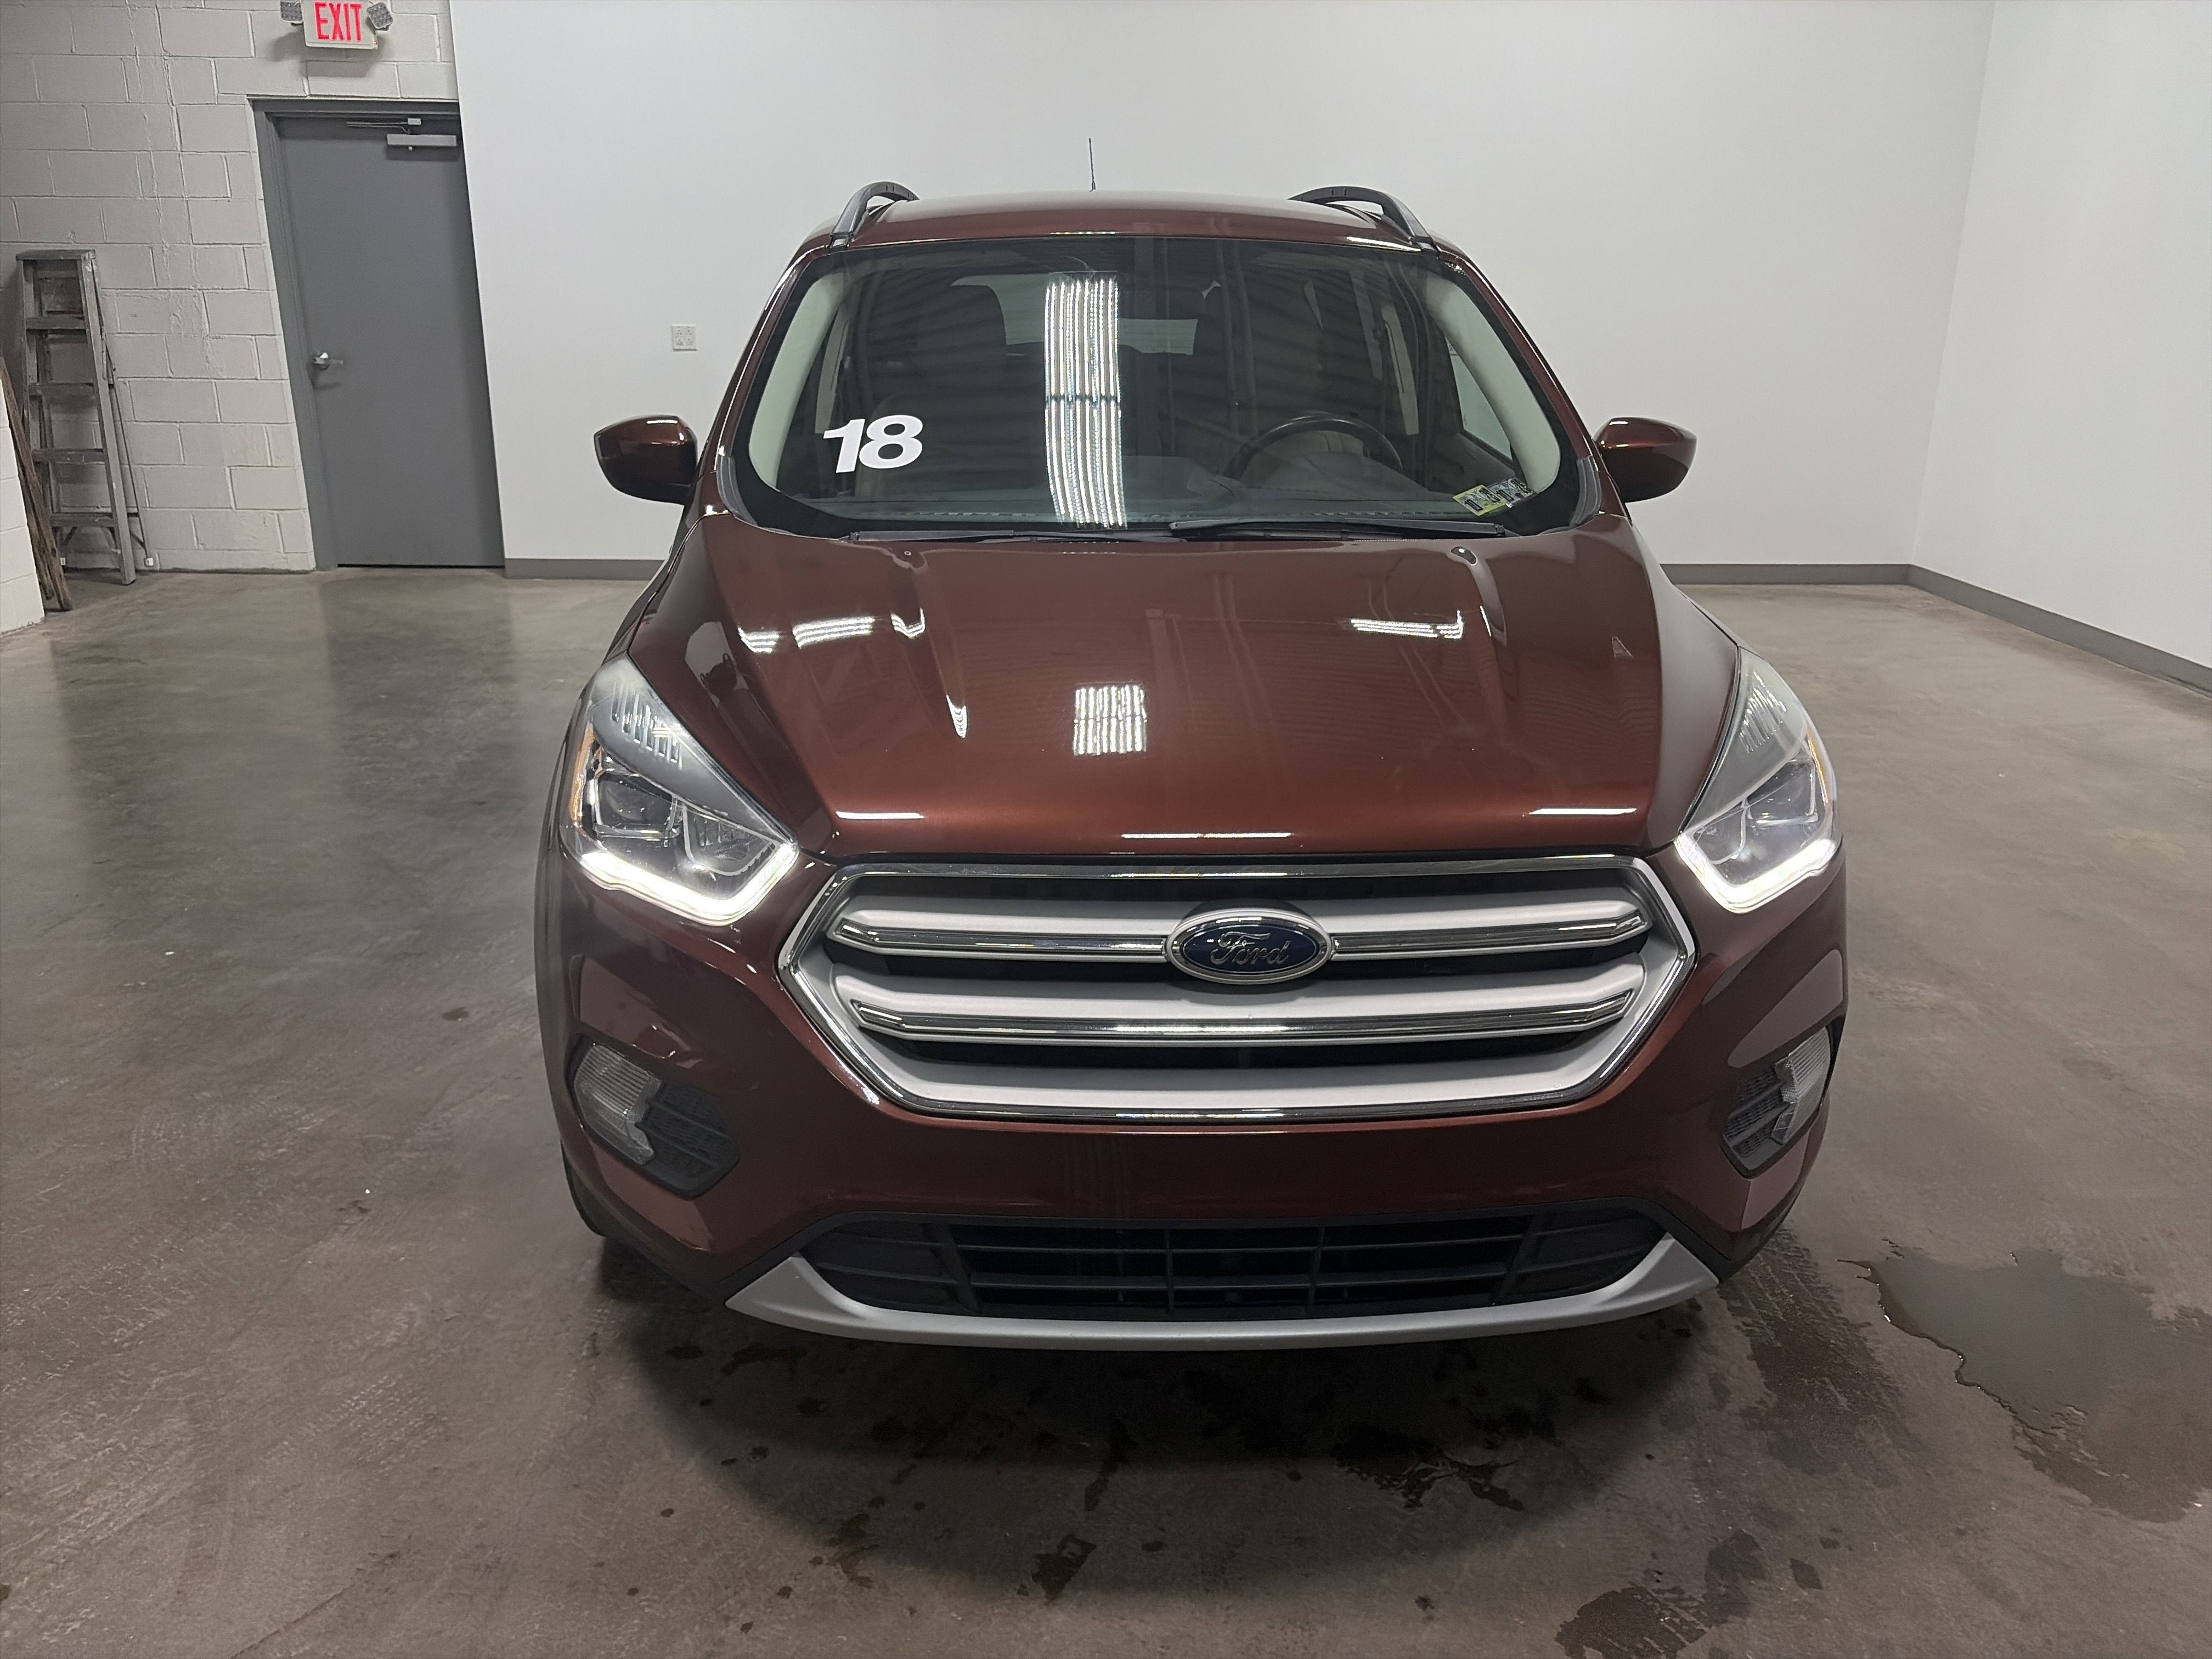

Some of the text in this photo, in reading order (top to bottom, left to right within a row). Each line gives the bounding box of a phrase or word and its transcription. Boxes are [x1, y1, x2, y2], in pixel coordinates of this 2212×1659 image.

[314, 1, 363, 42] EXIT
[823, 415, 923, 473] 18
[1210, 931, 1291, 966] Ford
